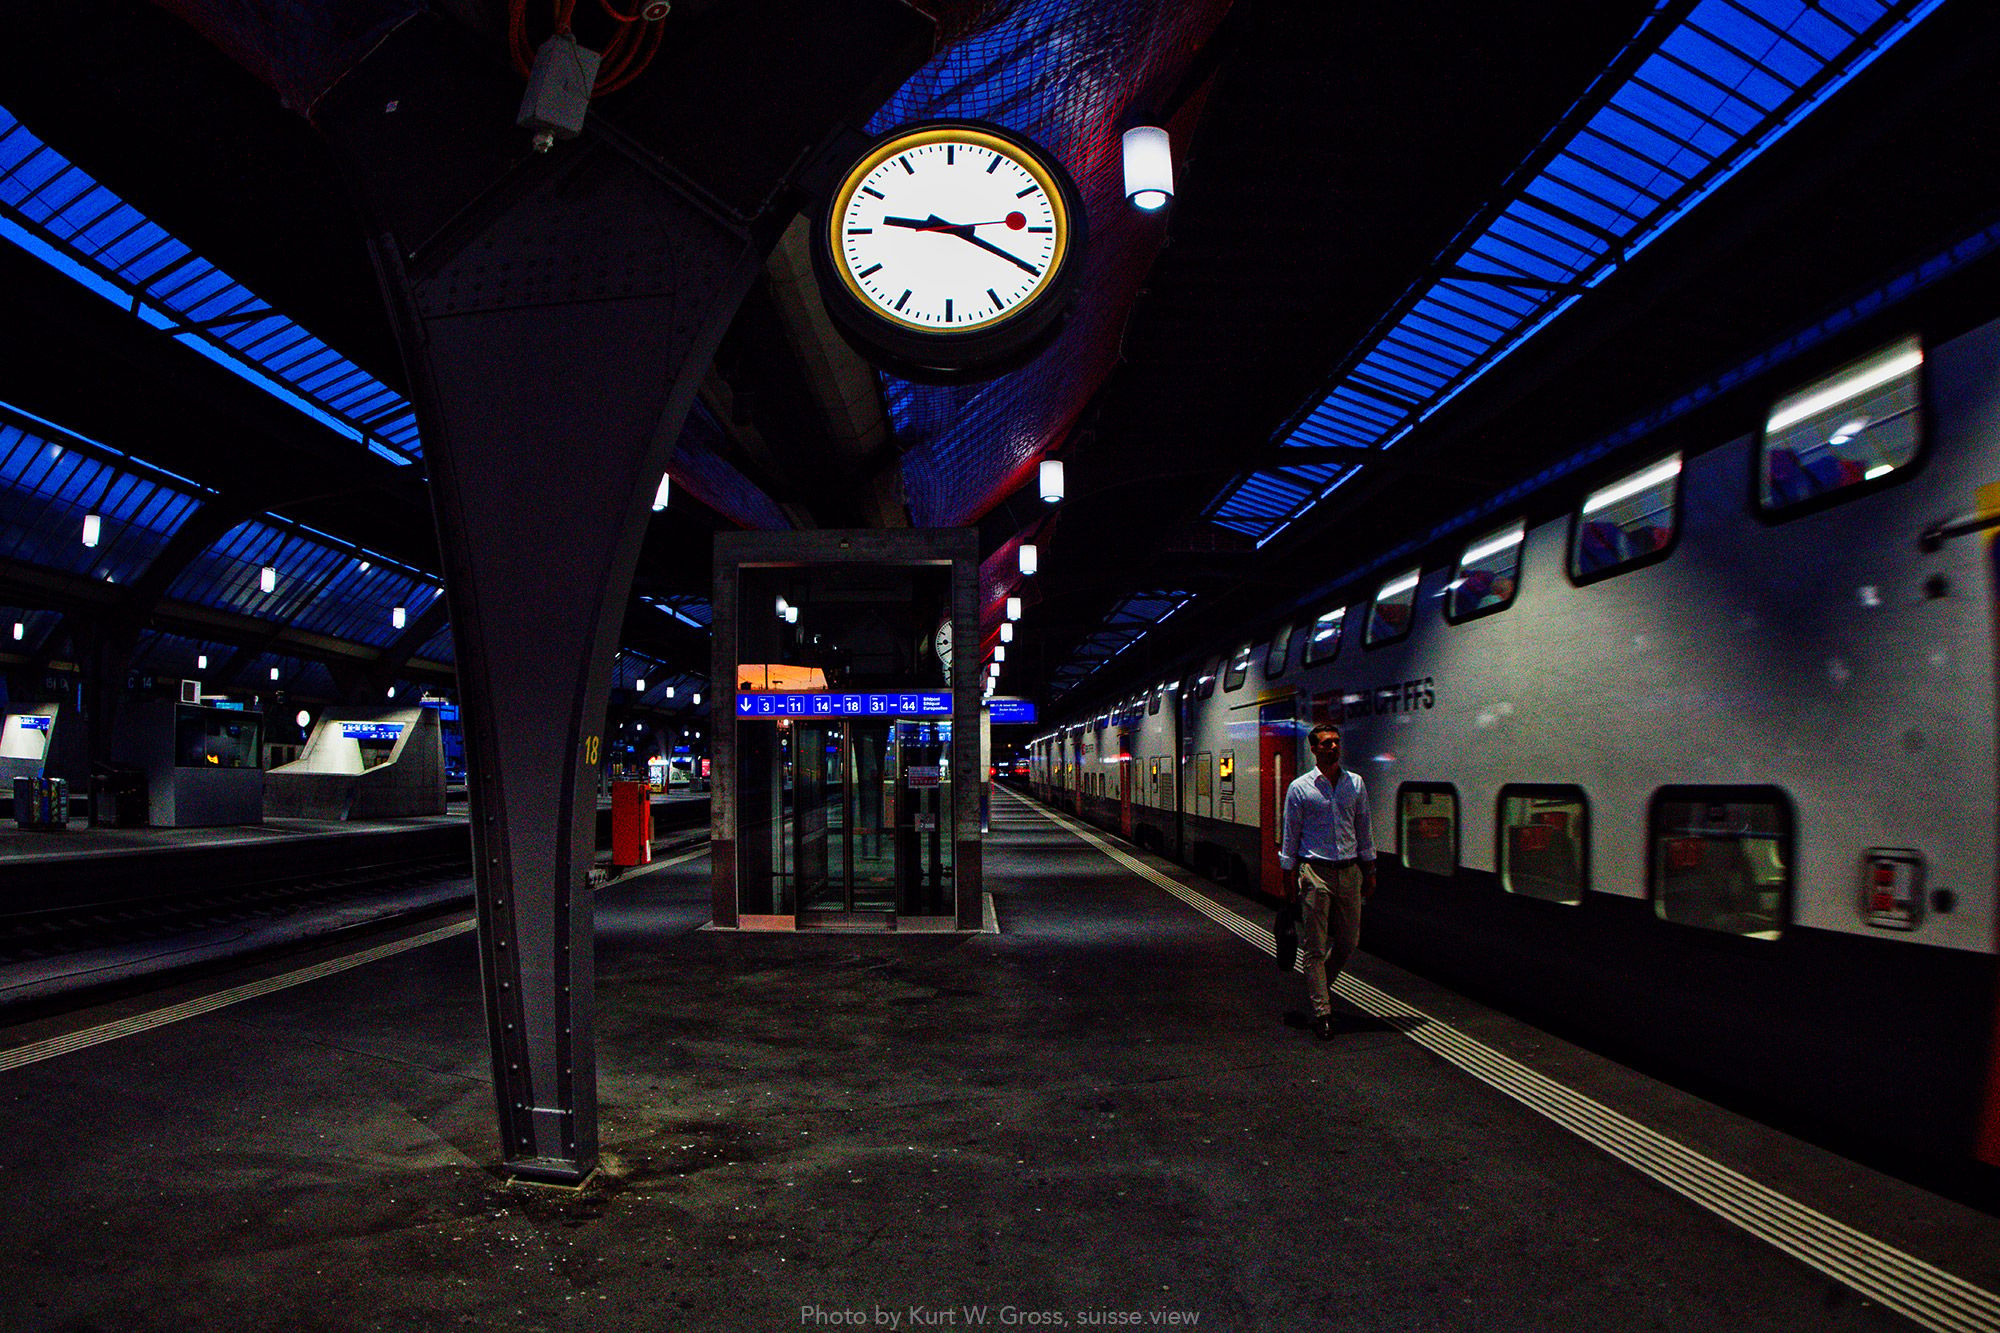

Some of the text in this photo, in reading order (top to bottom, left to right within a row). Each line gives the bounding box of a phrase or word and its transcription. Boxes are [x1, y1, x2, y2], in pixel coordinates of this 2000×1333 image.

[763, 702, 770, 712] 3
[790, 702, 801, 712] 11
[816, 702, 829, 712] 14
[846, 701, 859, 711] 18
[872, 701, 884, 711] 31
[902, 701, 915, 711] 44
[1404, 676, 1435, 712] FFS
[585, 735, 599, 766] 18
